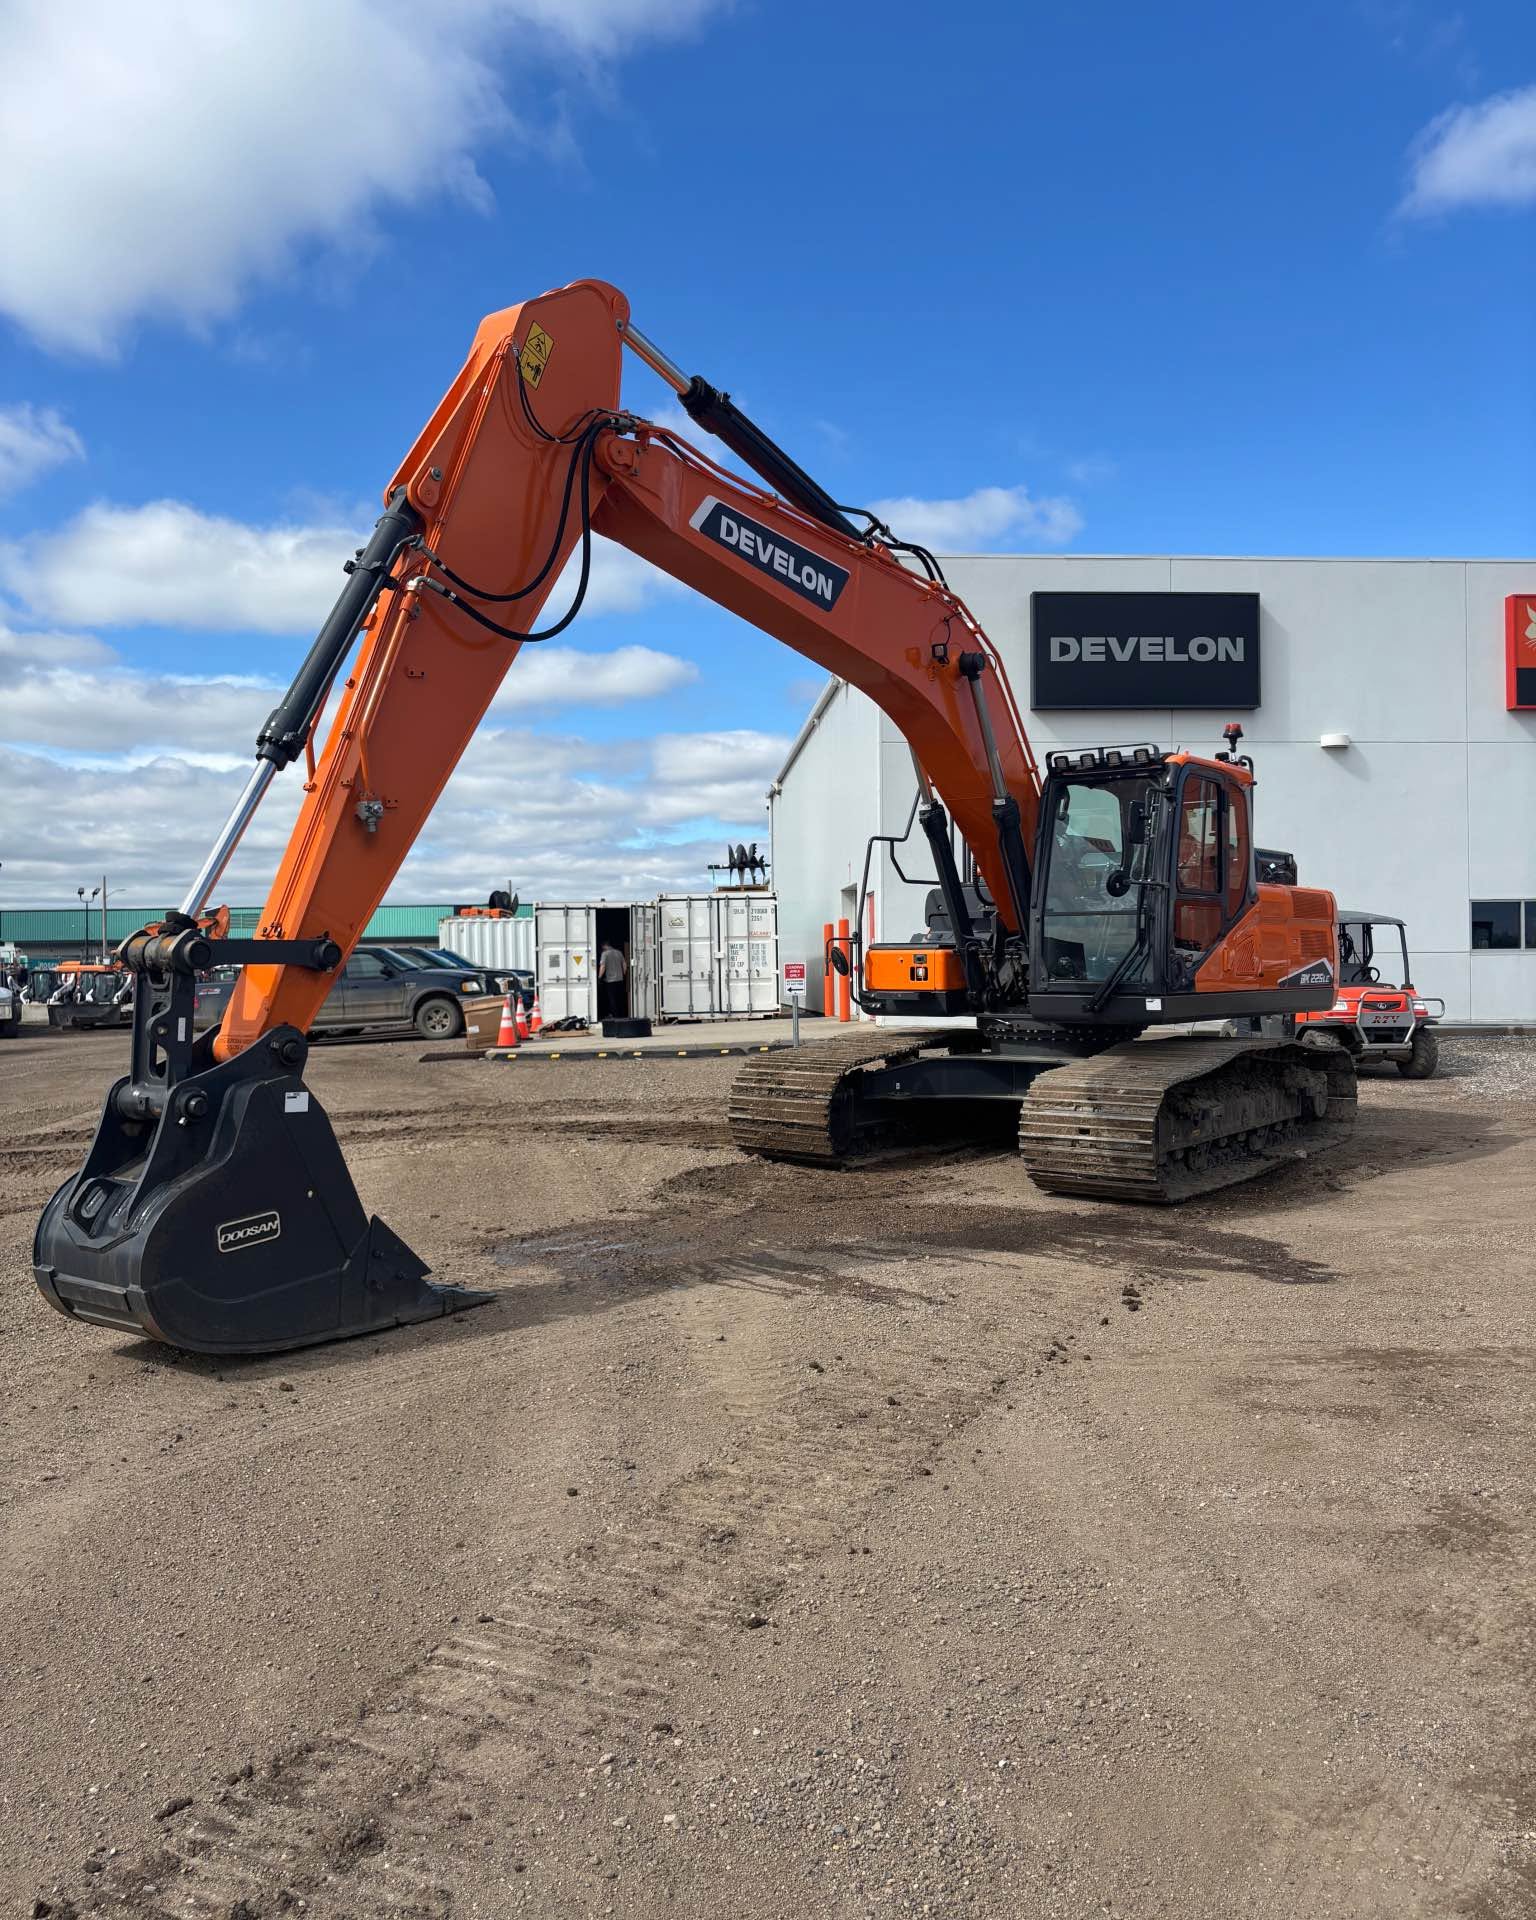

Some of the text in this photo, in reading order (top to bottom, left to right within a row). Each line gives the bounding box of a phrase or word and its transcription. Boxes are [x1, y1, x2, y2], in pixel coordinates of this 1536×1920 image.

[719, 515, 833, 601] DEVELON
[1050, 636, 1245, 662] DEVELON
[1371, 1015, 1400, 1024] RTV
[220, 1220, 279, 1244] DOOSAN
